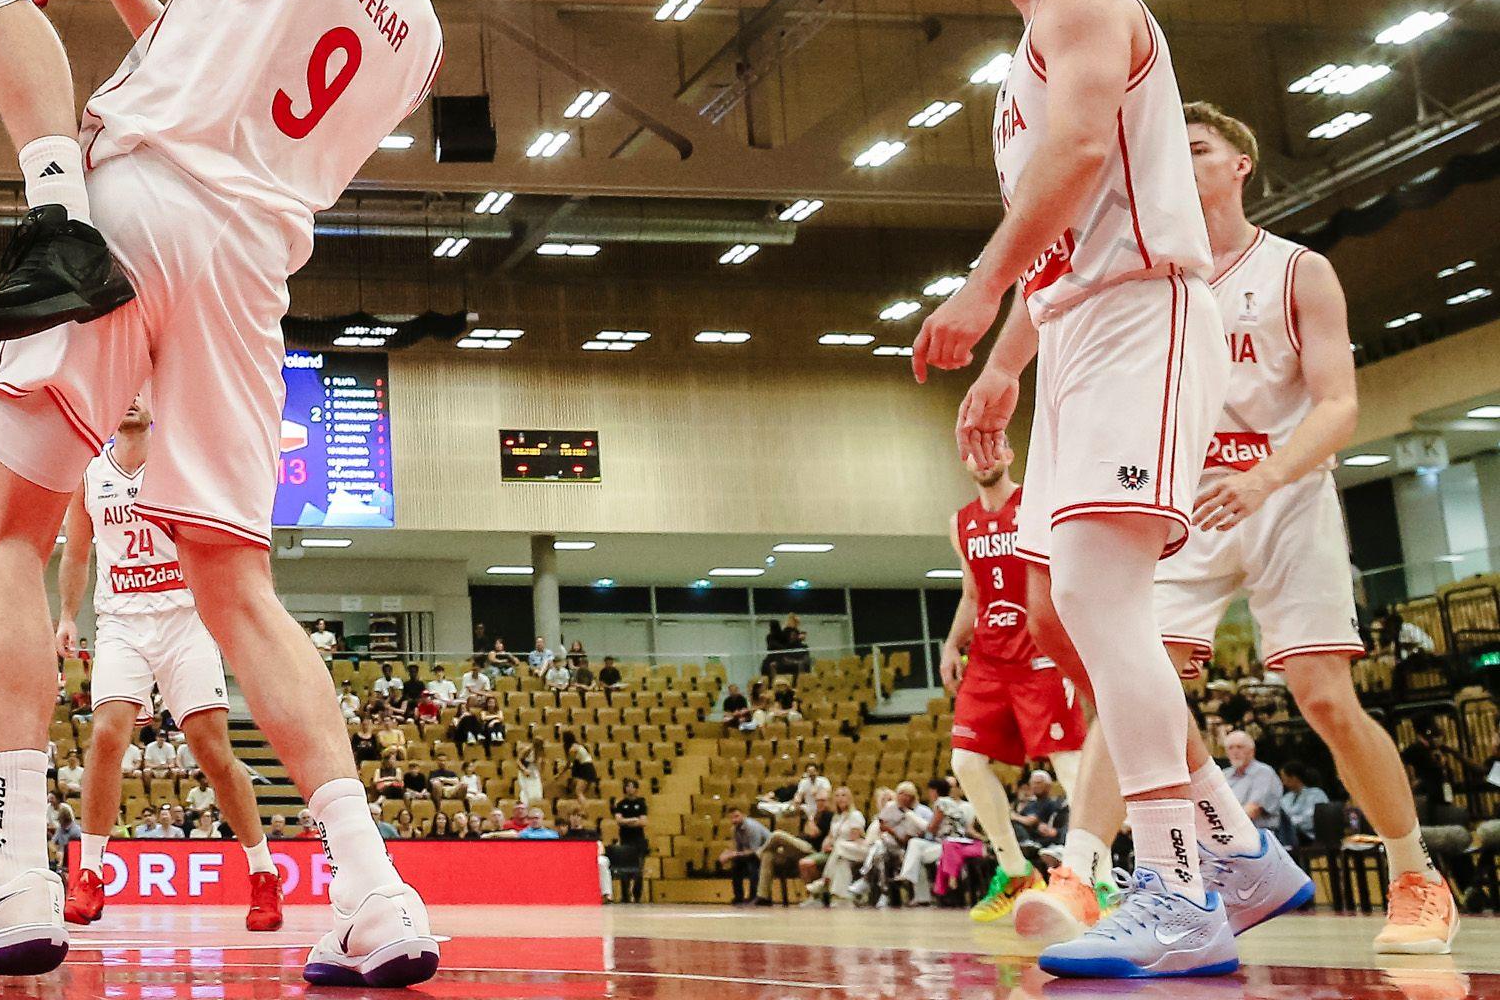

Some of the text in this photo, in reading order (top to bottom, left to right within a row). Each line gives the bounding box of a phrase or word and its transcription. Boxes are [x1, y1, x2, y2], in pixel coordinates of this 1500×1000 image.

[271, 26, 362, 140] 9
[283, 353, 323, 369] oland
[310, 406, 323, 422] 2
[278, 458, 308, 485] 13
[124, 528, 155, 560] 24
[992, 566, 1005, 590] 3
[988, 612, 1018, 628] PGE
[1198, 800, 1225, 832] CRAFT
[1171, 828, 1190, 868] CRAFT
